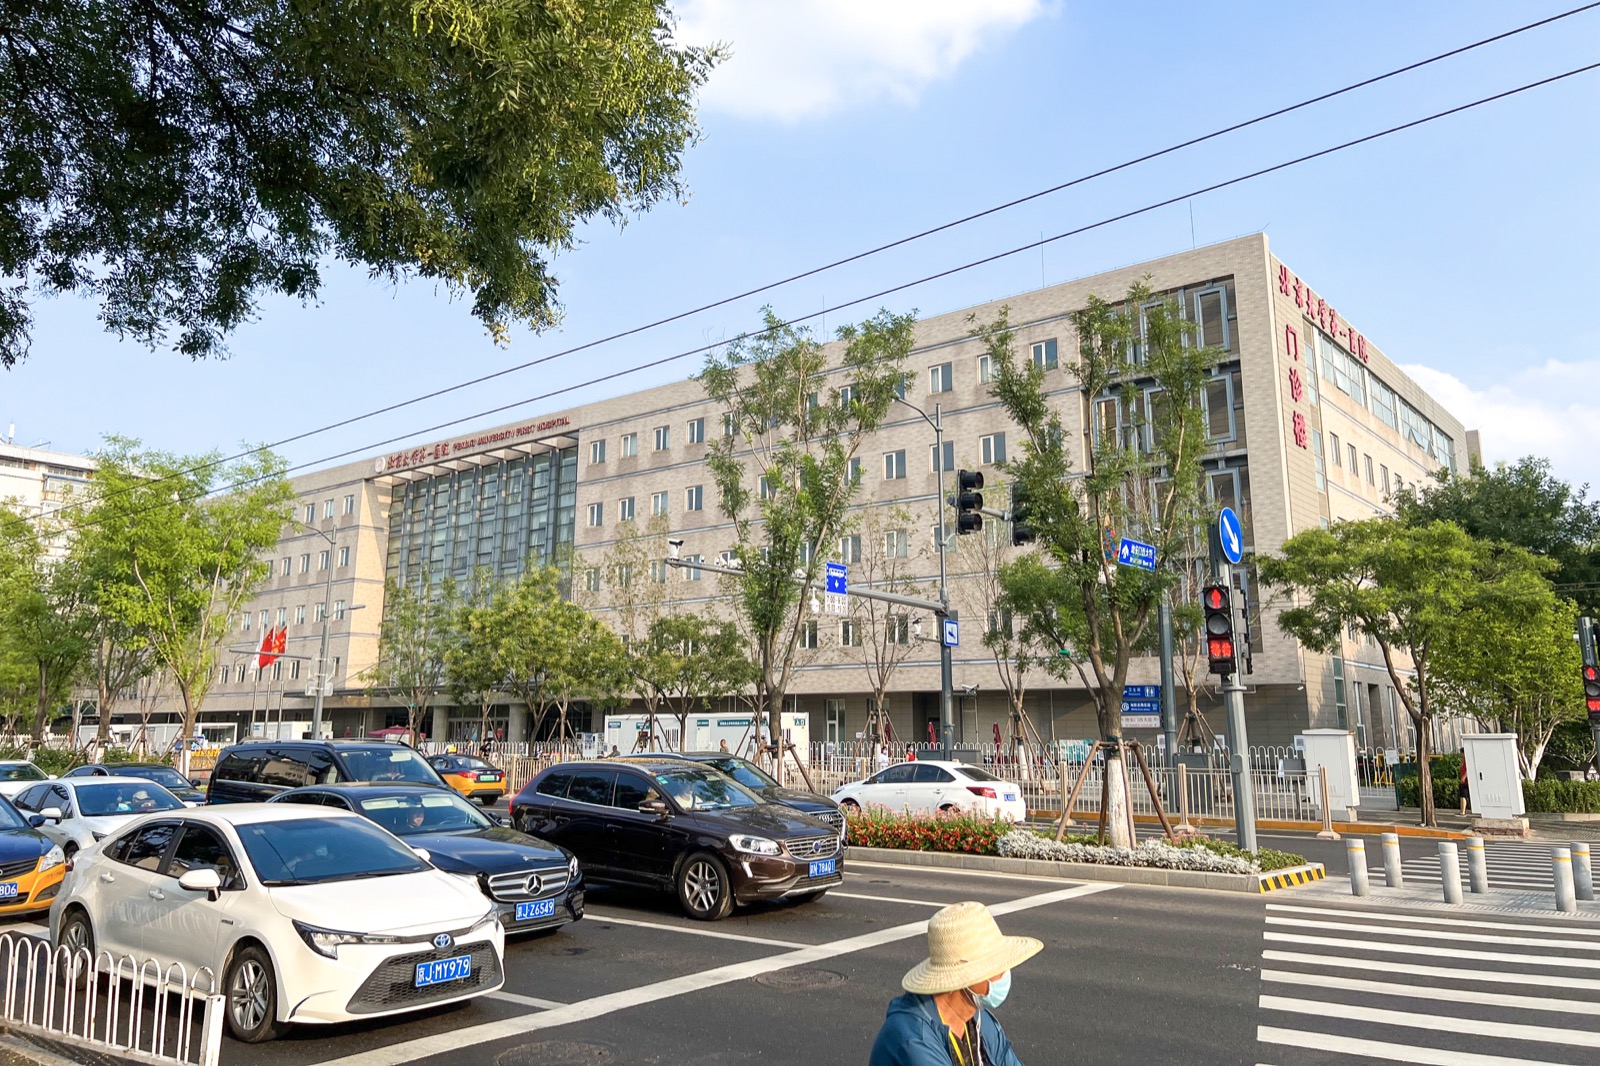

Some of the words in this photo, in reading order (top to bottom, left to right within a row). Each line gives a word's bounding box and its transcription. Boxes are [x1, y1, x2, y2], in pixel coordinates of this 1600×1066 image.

[1279, 264, 1369, 364] 北京大学第一医院
[1286, 323, 1307, 449] 门诊楼
